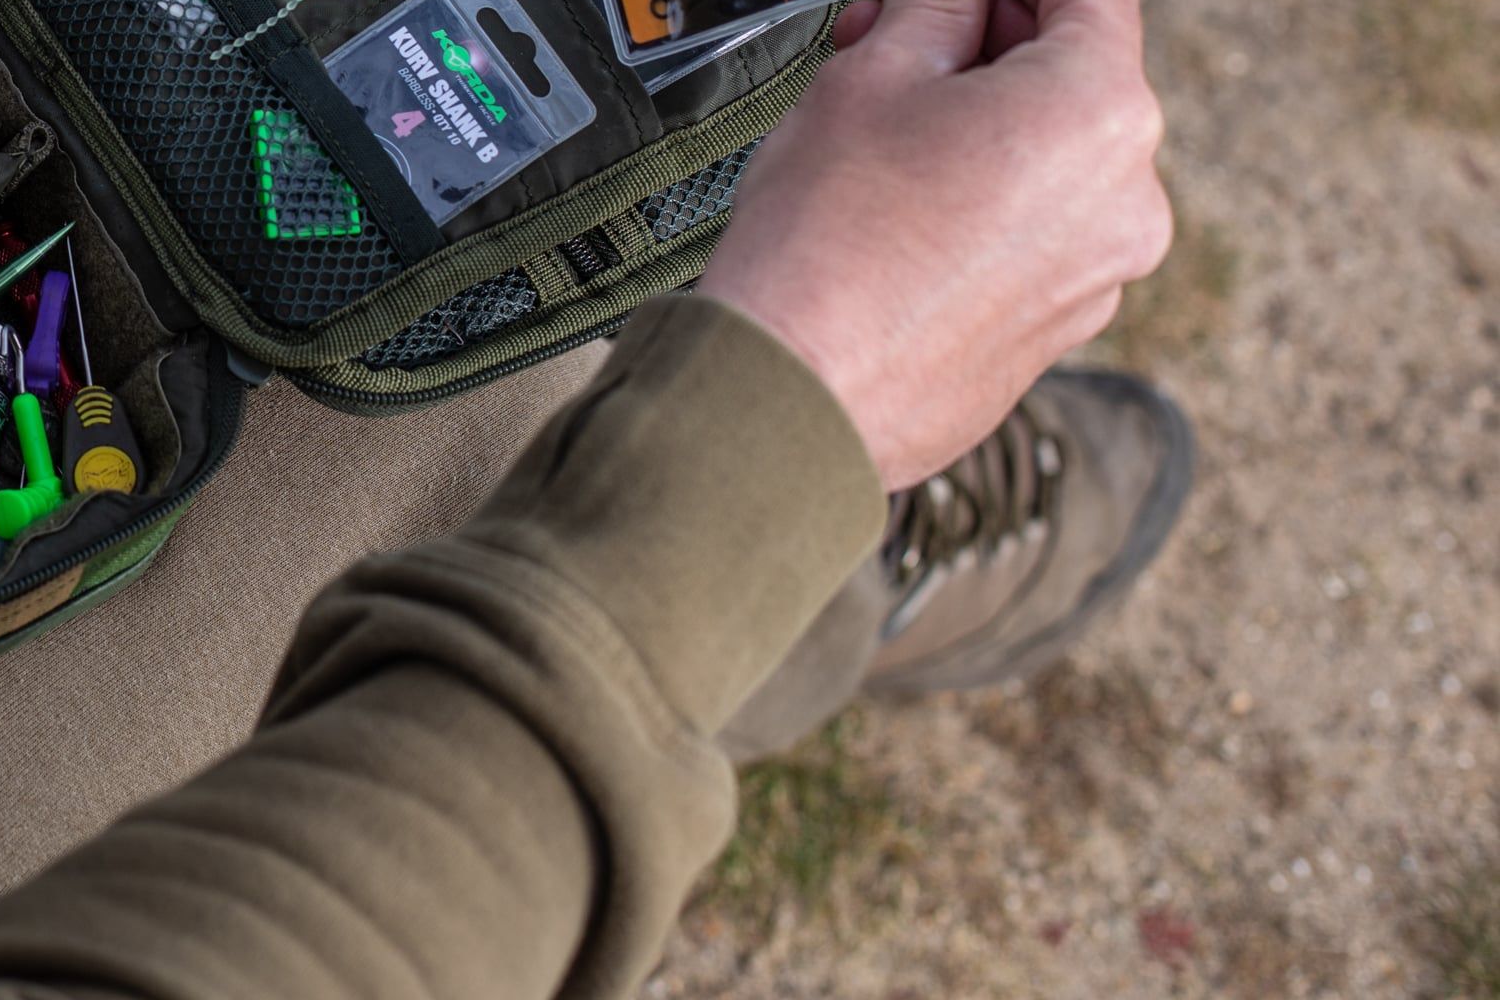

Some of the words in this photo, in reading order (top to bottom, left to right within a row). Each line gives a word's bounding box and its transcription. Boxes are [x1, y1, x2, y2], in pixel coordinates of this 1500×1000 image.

[388, 26, 439, 81] KURV
[428, 79, 488, 149] SHANK
[476, 142, 499, 163] B
[391, 110, 426, 139] 4
[398, 67, 435, 111] BARBLESS
[433, 114, 452, 132] QTY
[446, 132, 461, 145] 10
